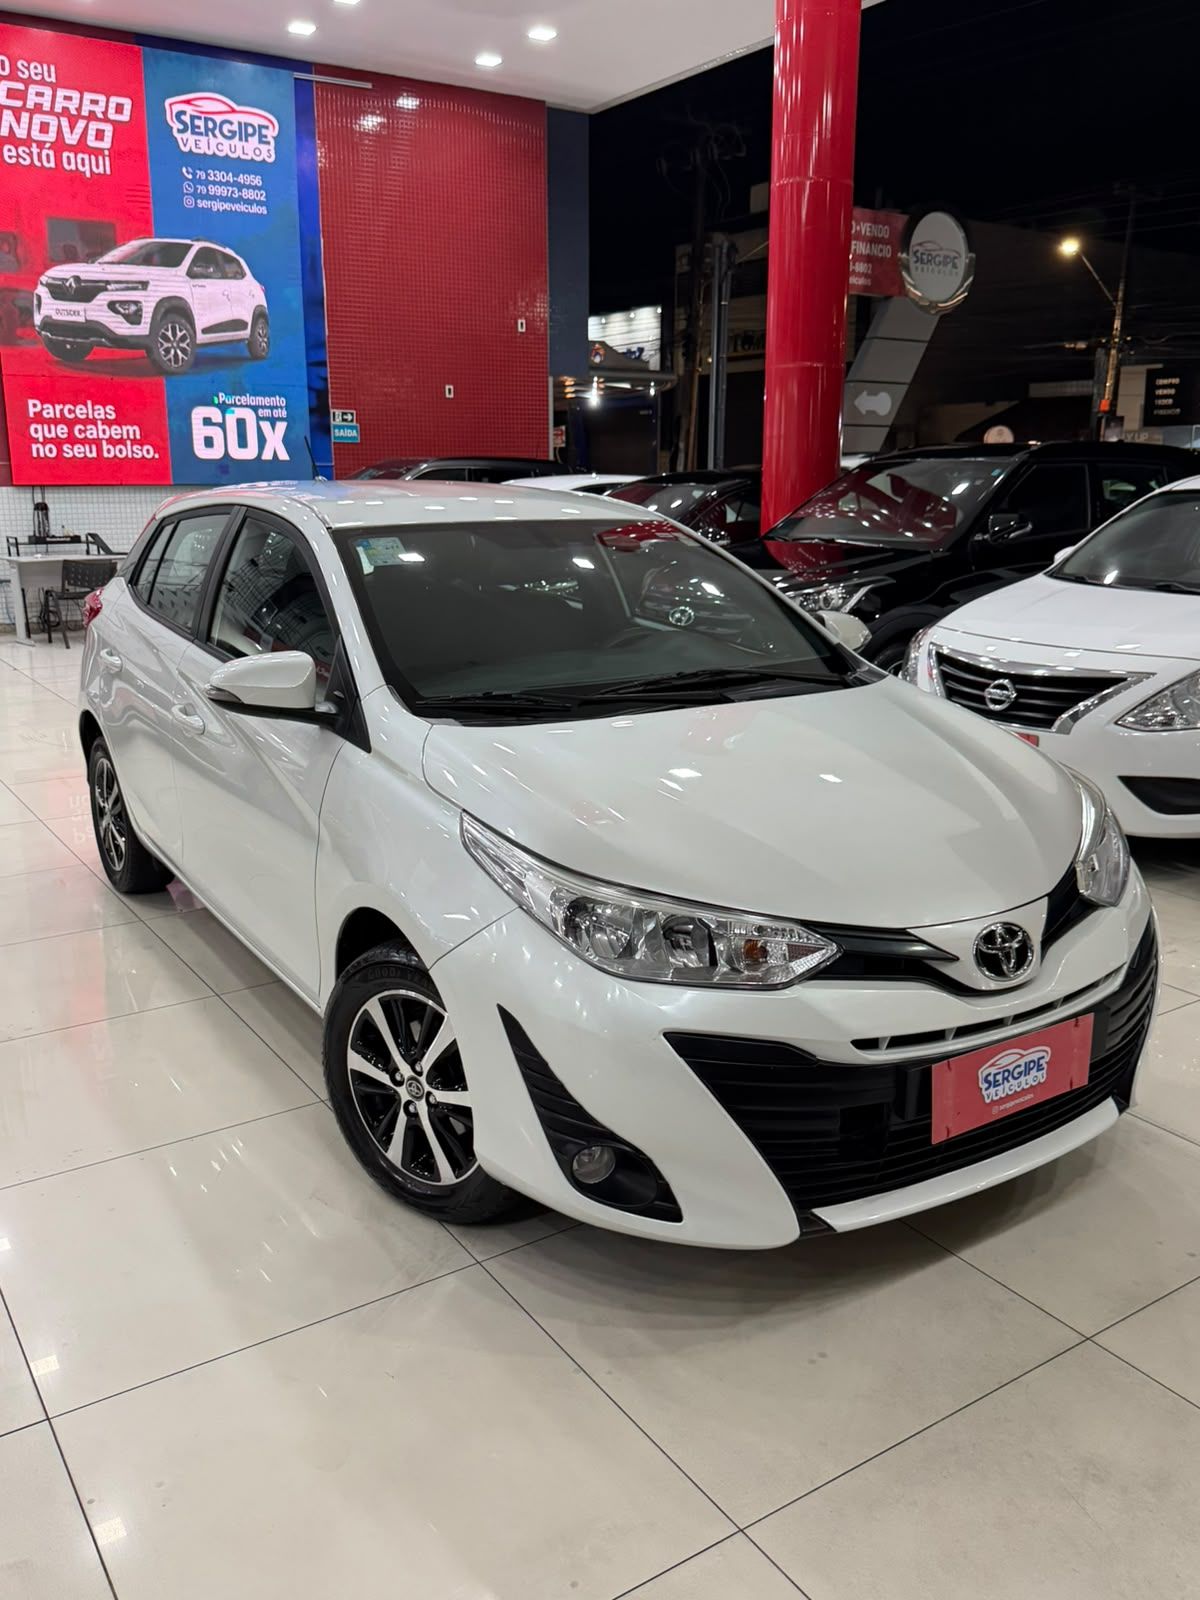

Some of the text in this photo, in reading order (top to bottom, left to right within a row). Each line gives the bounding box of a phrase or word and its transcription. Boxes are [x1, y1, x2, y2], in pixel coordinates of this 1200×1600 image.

[16, 59, 57, 83] seu
[0, 80, 133, 122] CARRO
[0, 109, 113, 149] NOVO
[174, 110, 271, 146] SERGIPE
[180, 136, 273, 159] VEÍCULOS
[2, 143, 112, 178] está aqui
[207, 169, 263, 187] 3304-4956
[207, 184, 266, 202] 99973-8802
[196, 199, 268, 215] sergipeveiculos
[850, 240, 892, 258] FINANCIO
[912, 250, 959, 270] SERGIPE
[27, 399, 116, 420] Parcelas
[218, 392, 286, 406] Parcelamento
[258, 407, 287, 418] em até
[29, 419, 141, 442] que cabem
[191, 406, 290, 460] 60x
[334, 428, 358, 438] SAÍDA
[31, 440, 159, 459] no seu bolso.
[983, 1055, 1046, 1092] SERGIPE
